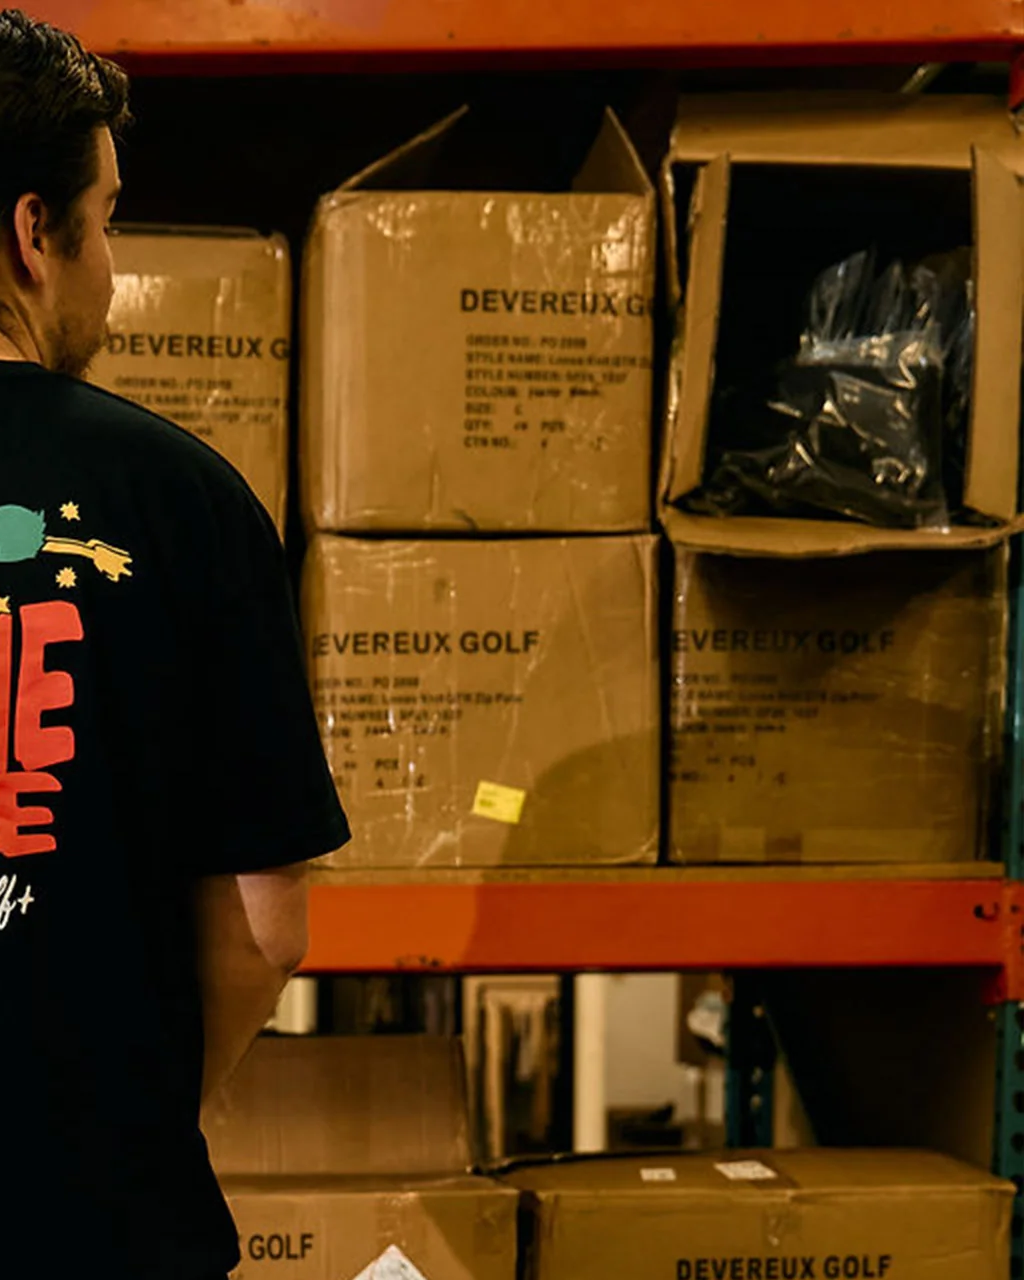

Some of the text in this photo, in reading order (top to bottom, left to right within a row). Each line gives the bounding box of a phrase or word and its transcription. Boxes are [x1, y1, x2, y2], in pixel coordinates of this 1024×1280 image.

[460, 289, 618, 317] DEVEREUX
[108, 333, 263, 358] DEVEREUX
[312, 630, 541, 656] EVEREUX GOLF
[673, 629, 896, 654] EVEREUX GOLF
[248, 1233, 314, 1260] GOLF
[824, 1254, 892, 1280] GOLF
